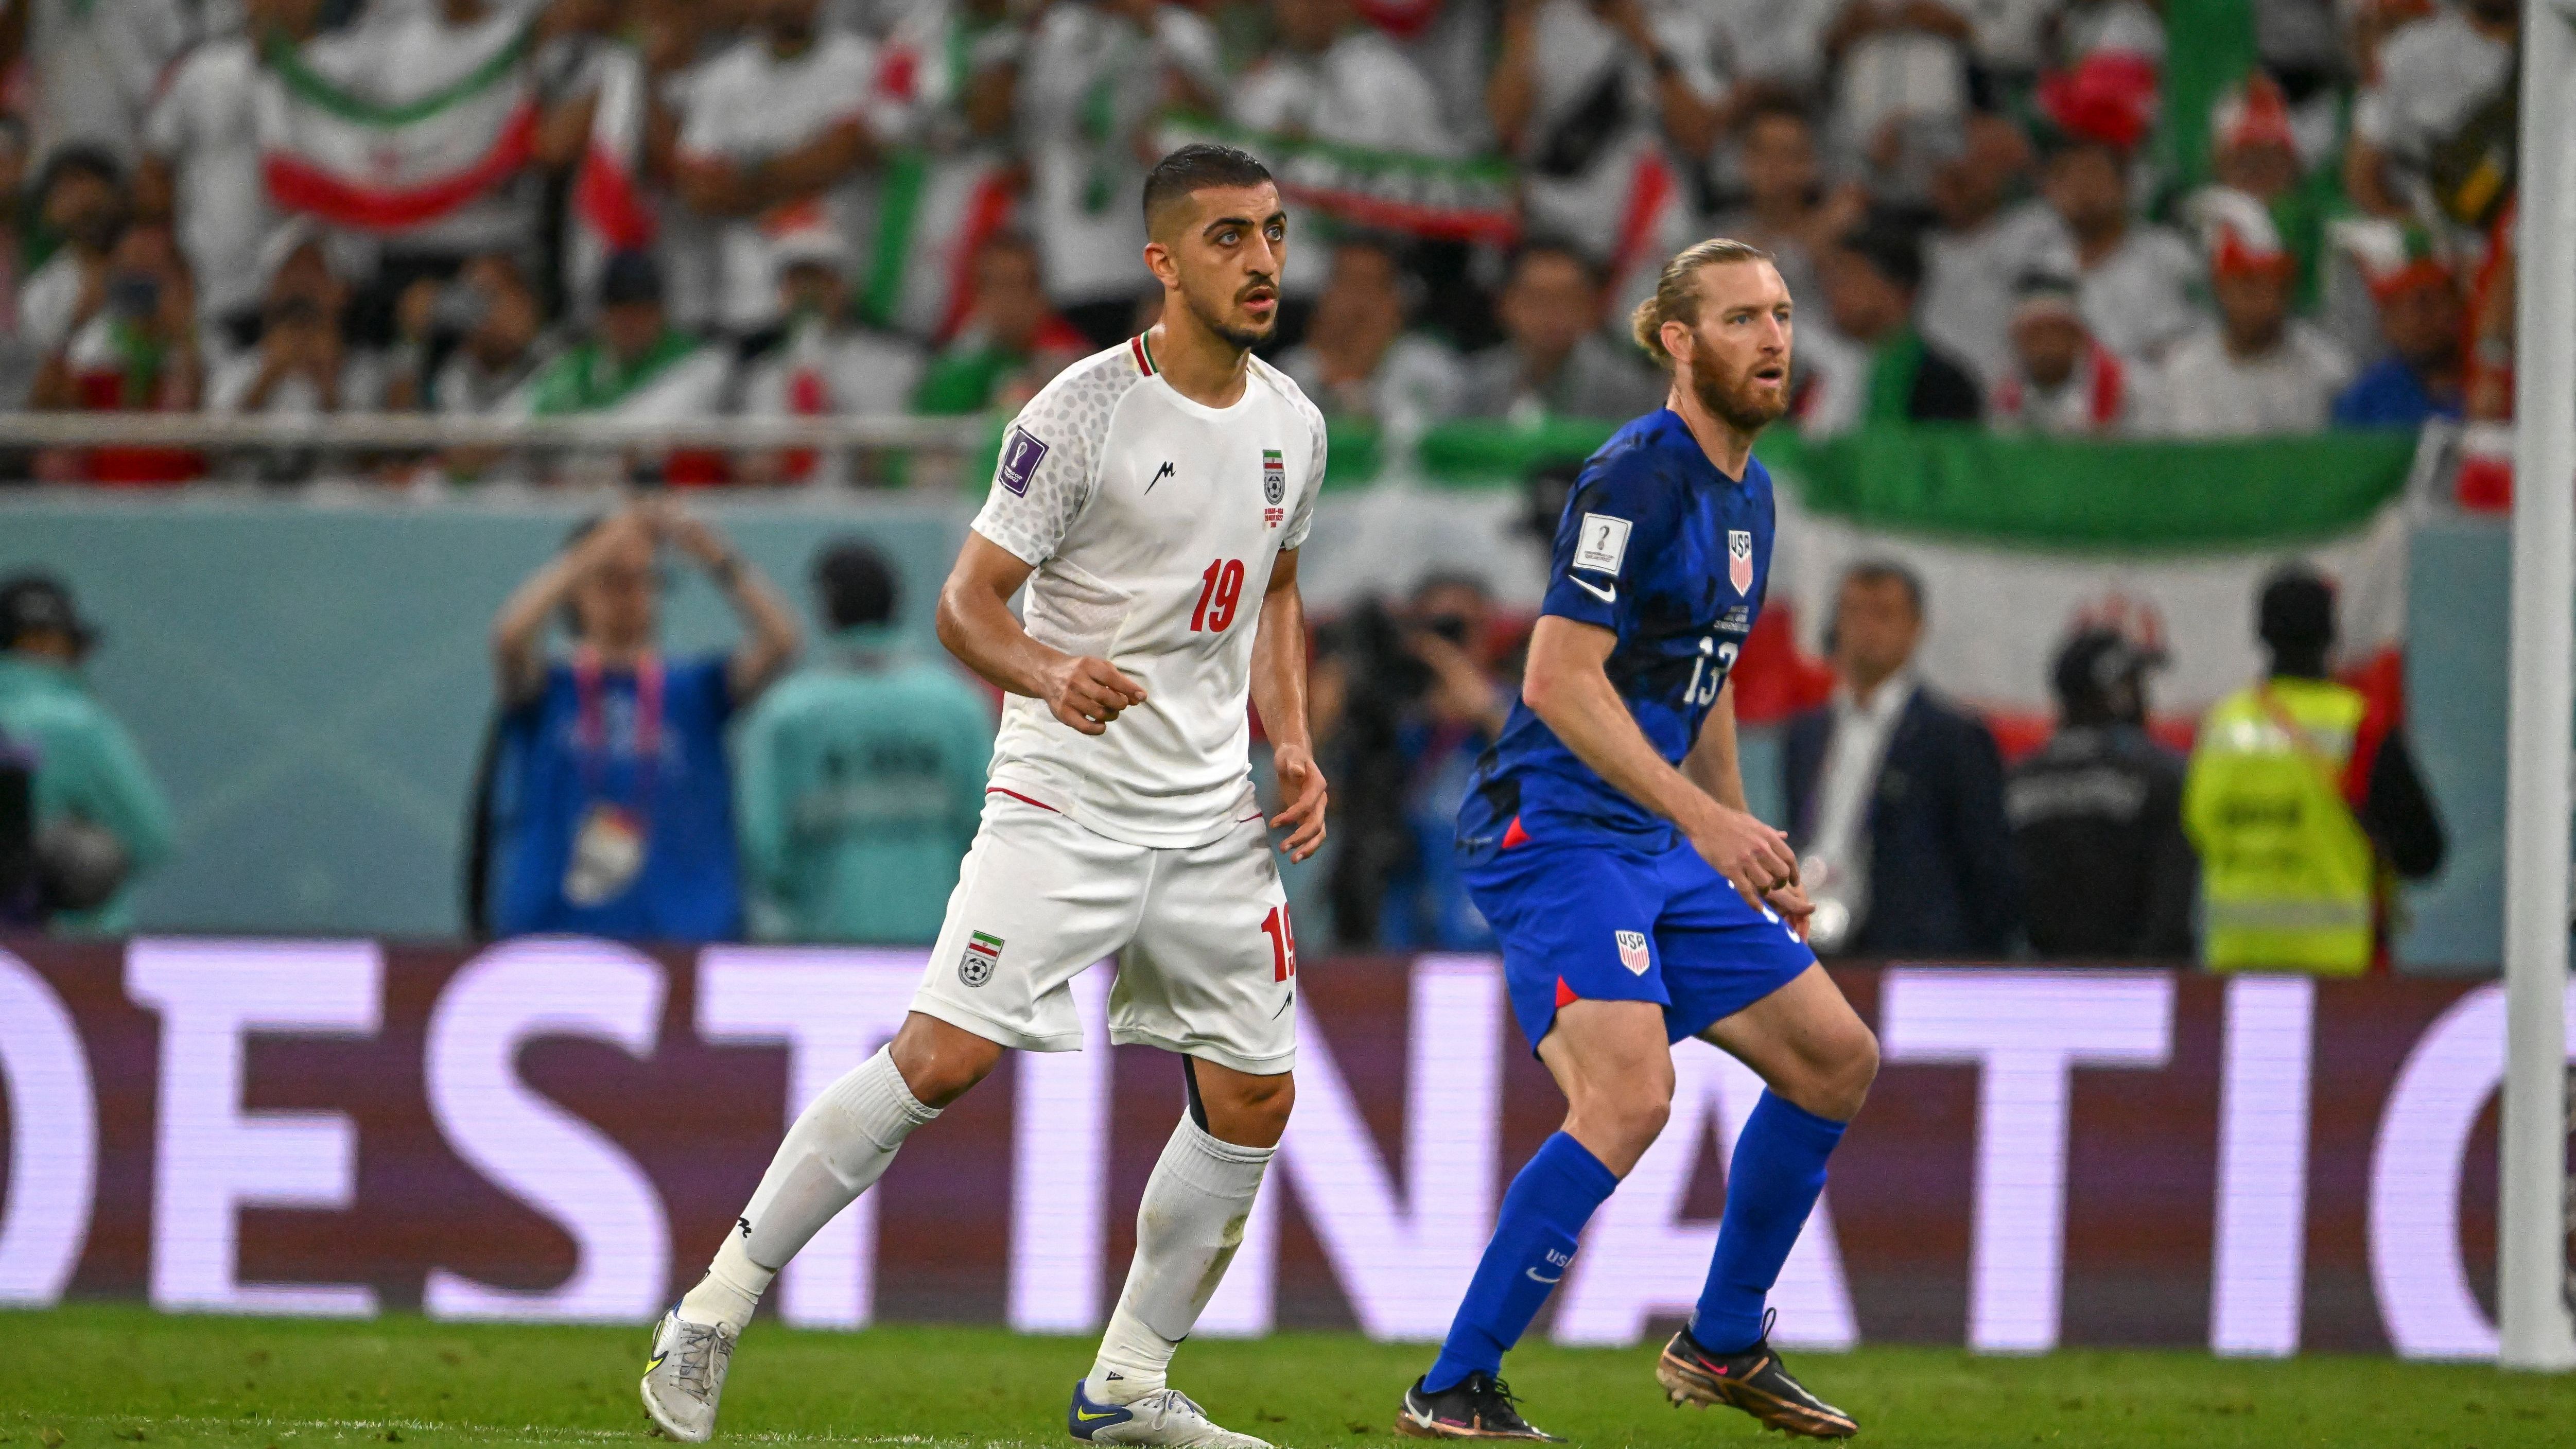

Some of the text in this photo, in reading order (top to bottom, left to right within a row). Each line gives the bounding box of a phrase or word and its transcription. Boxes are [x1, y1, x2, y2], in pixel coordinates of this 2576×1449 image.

[1731, 533, 1749, 558] USA
[1190, 558, 1245, 633] 19
[1684, 636, 1739, 706] 13
[1261, 902, 1296, 983] 19
[1618, 933, 1644, 950] USA
[1546, 1248, 1573, 1269] US
